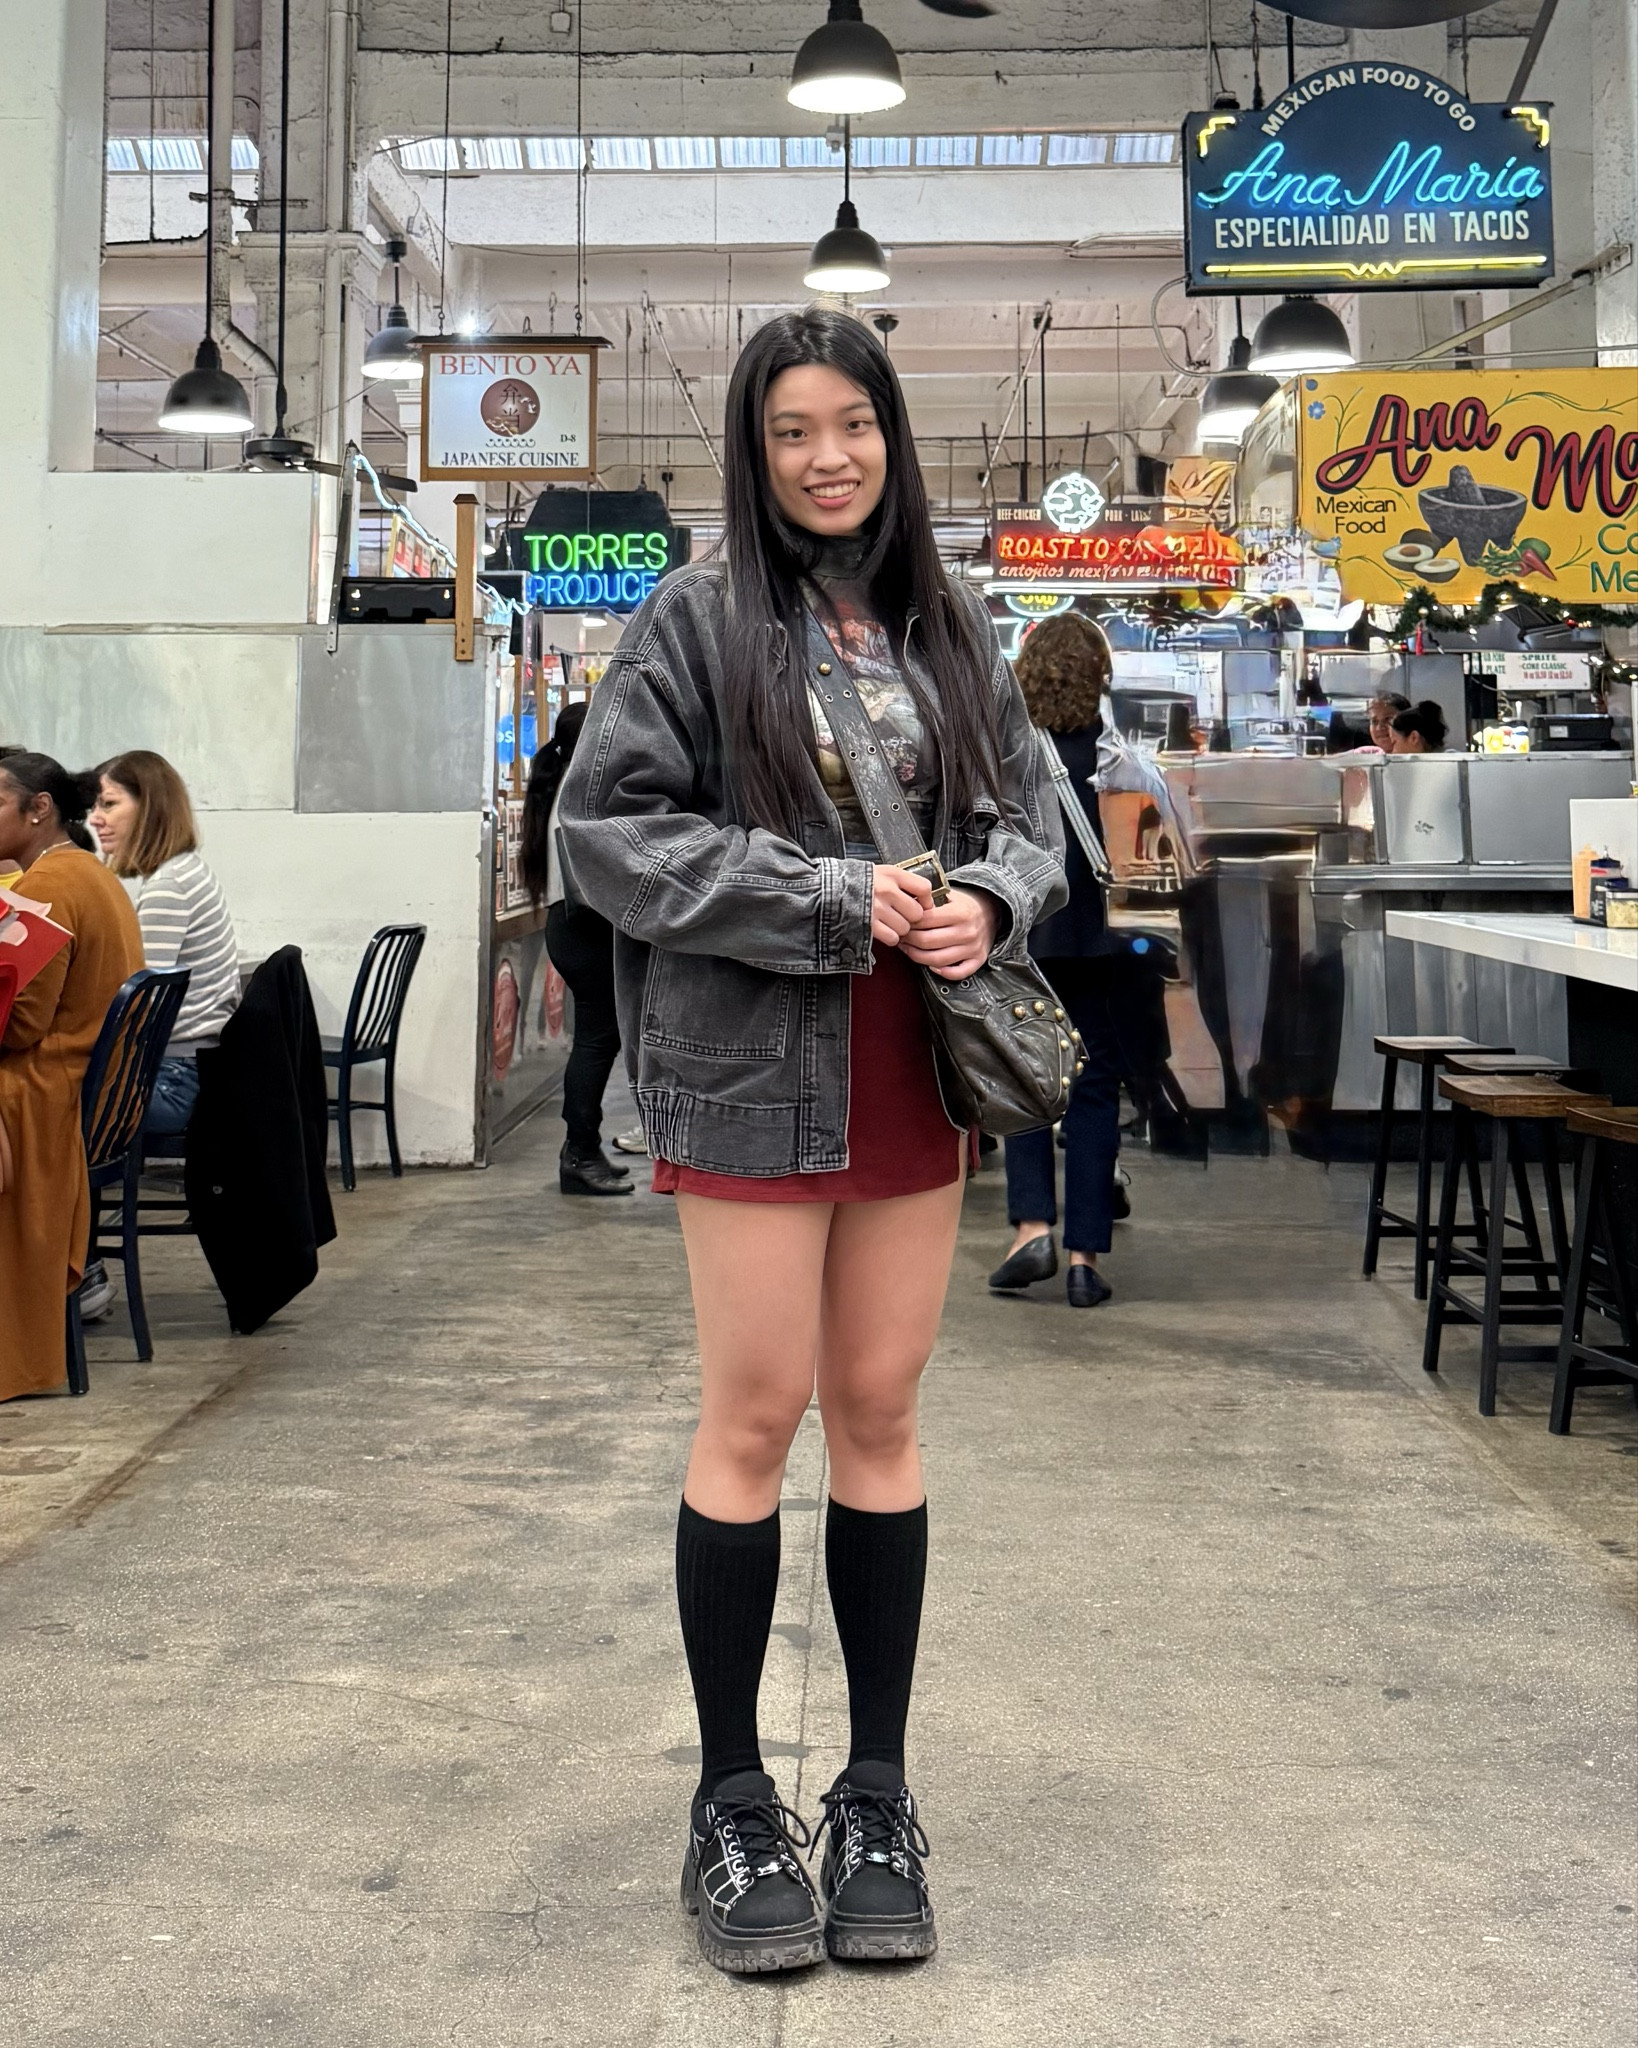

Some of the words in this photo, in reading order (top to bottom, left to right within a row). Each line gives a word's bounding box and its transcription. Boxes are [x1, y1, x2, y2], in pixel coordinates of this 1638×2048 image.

[1261, 68, 1357, 137] MEXICAN
[1361, 66, 1421, 93] FOOD
[1424, 80, 1451, 107] TO
[1448, 101, 1477, 133] GO
[1198, 142, 1341, 207] Ana
[1343, 140, 1545, 207] María
[1215, 214, 1390, 249] ESPECIALIDAD
[1404, 212, 1436, 243] EN
[1449, 209, 1530, 242] TACOS
[439, 355, 537, 376] BENTO
[543, 355, 582, 376] YA
[560, 434, 577, 443] D-8
[1316, 393, 1502, 495] Ana
[441, 451, 516, 467] JAPANESE
[518, 451, 580, 467] CUISINE
[1316, 496, 1397, 516] Mexican
[1335, 517, 1386, 535] Food
[523, 532, 669, 573] TORRES
[1000, 536, 1075, 560] ROAST
[1079, 536, 1110, 560] TO
[998, 562, 1064, 582] antojitos
[529, 571, 659, 606] PRODUCE
[1522, 662, 1540, 670] COKE
[1541, 662, 1567, 670] CLASSIC
